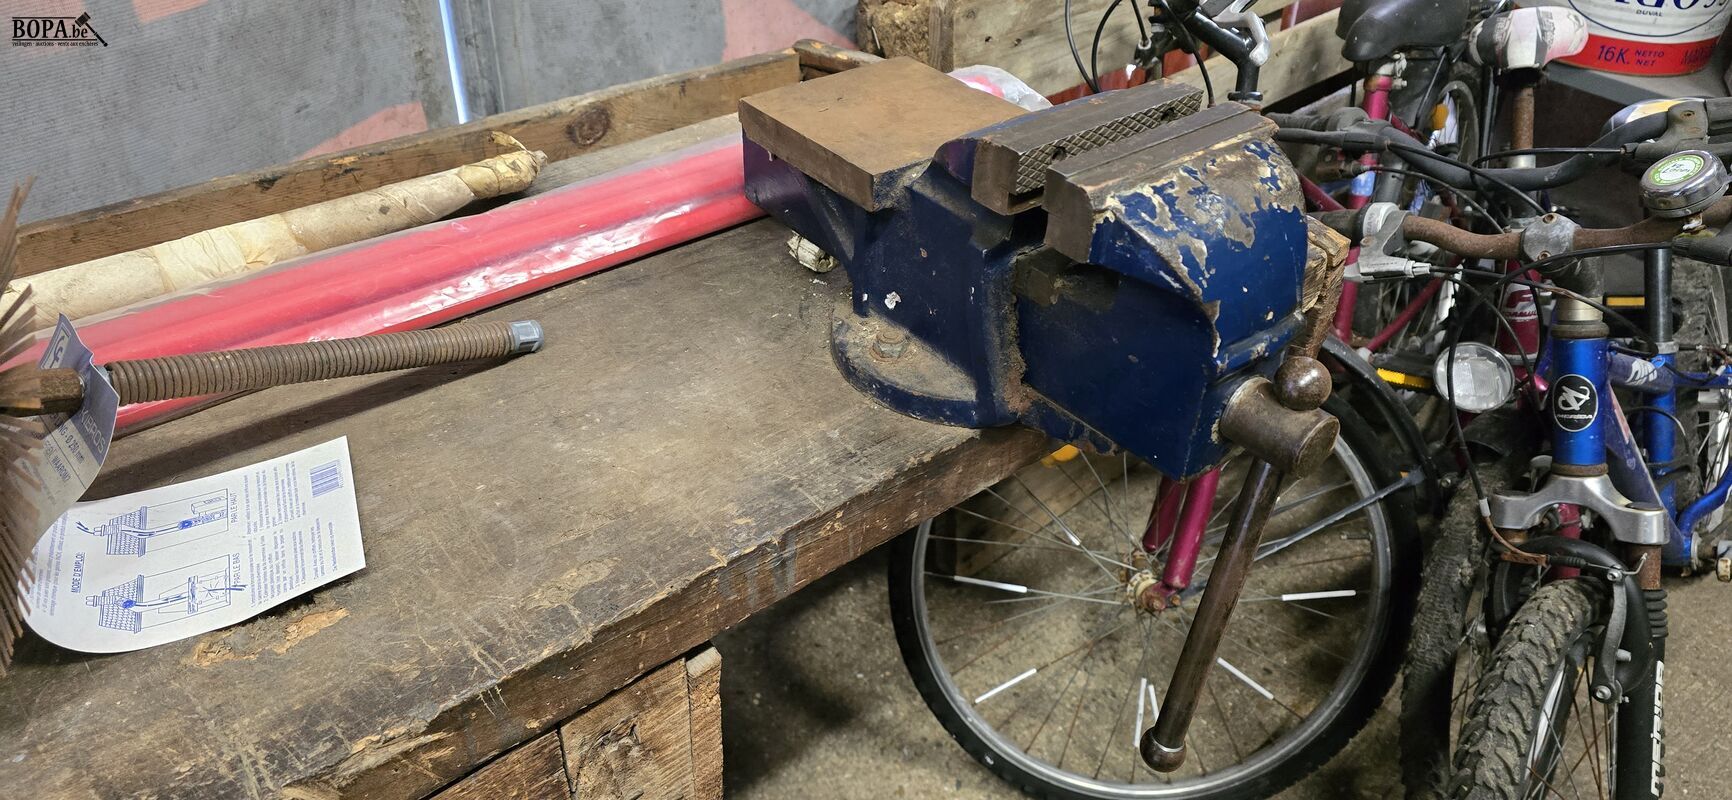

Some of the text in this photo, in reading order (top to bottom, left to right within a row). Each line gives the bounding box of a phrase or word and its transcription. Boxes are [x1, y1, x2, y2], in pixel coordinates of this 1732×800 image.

[1635, 9, 1663, 17] DUVAL
[1634, 49, 1665, 58] NETTO
[71, 577, 81, 593] MODE
